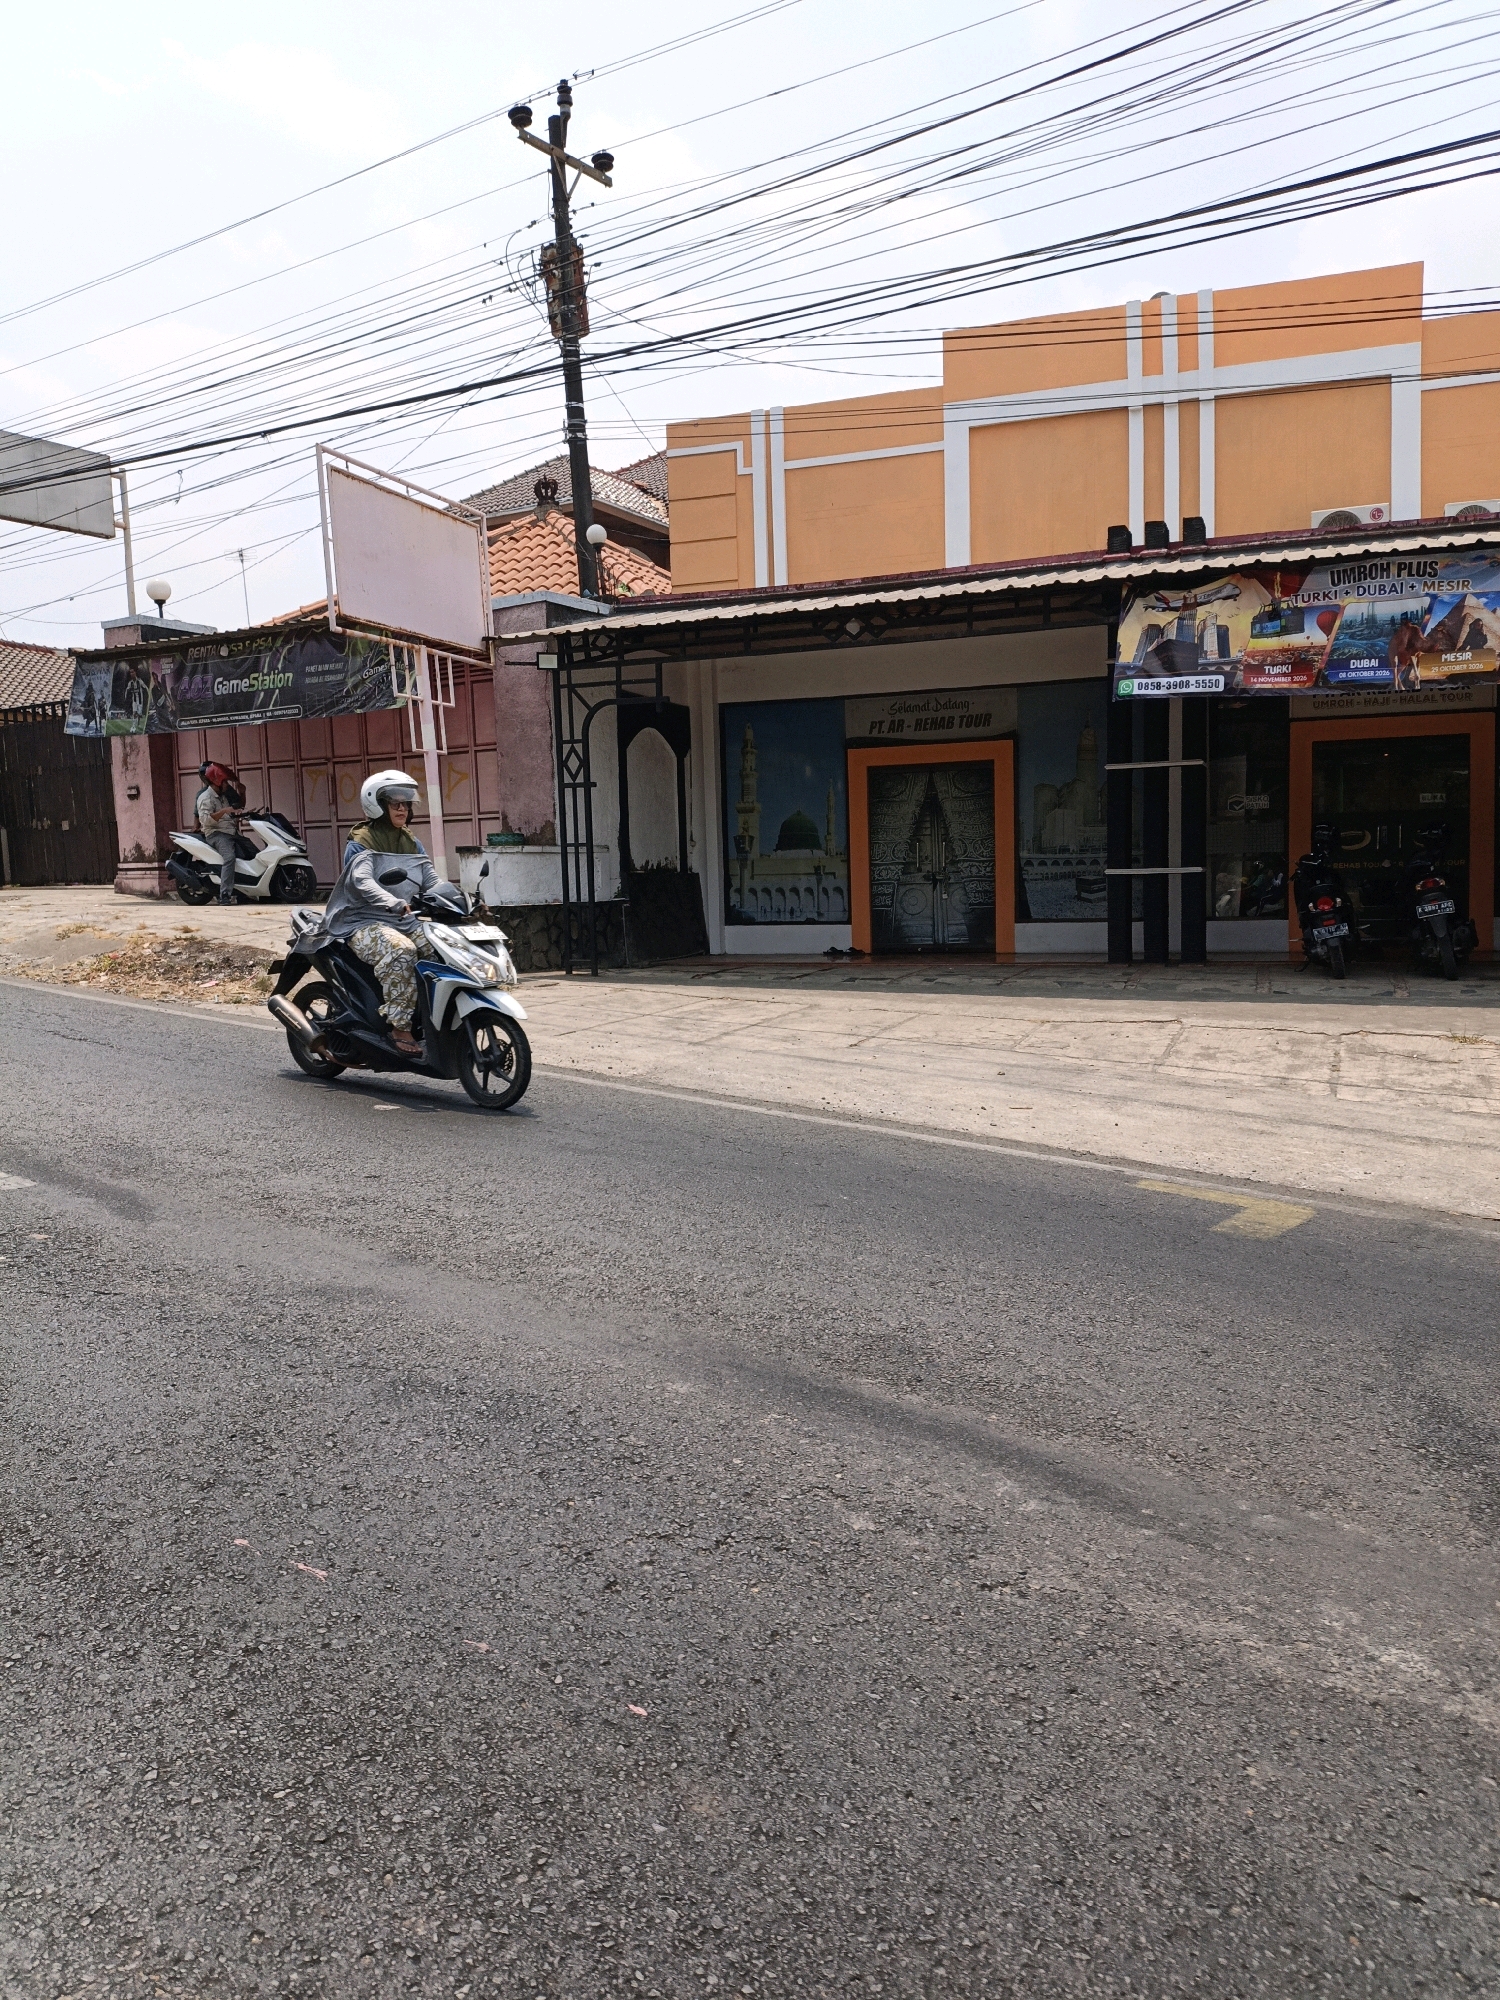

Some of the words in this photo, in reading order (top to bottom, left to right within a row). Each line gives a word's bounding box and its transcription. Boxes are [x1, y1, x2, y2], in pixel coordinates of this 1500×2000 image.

[1330, 562, 1391, 587] UMROH
[1396, 560, 1439, 578] PLUS
[1292, 590, 1338, 605] TURKI
[1356, 582, 1404, 597] DUBAI
[1421, 580, 1472, 592] MESIR
[1350, 659, 1379, 669] DUBAI
[1441, 652, 1472, 662] MESIR
[1264, 664, 1292, 674] TURKI
[1440, 664, 1467, 672] OKTOBER
[214, 669, 293, 696] GameStation
[1137, 678, 1220, 690] 0858-3908-5550
[888, 699, 931, 716] Selamat
[931, 697, 970, 713] Datang
[1312, 698, 1354, 709] UMROH
[1363, 696, 1391, 706] HAJI
[1399, 694, 1438, 704] HALAL
[1439, 692, 1472, 702] TOUR
[869, 720, 885, 734] PT.
[887, 718, 904, 734] AR
[914, 716, 955, 732] REHAB
[958, 713, 992, 729] TOUR
